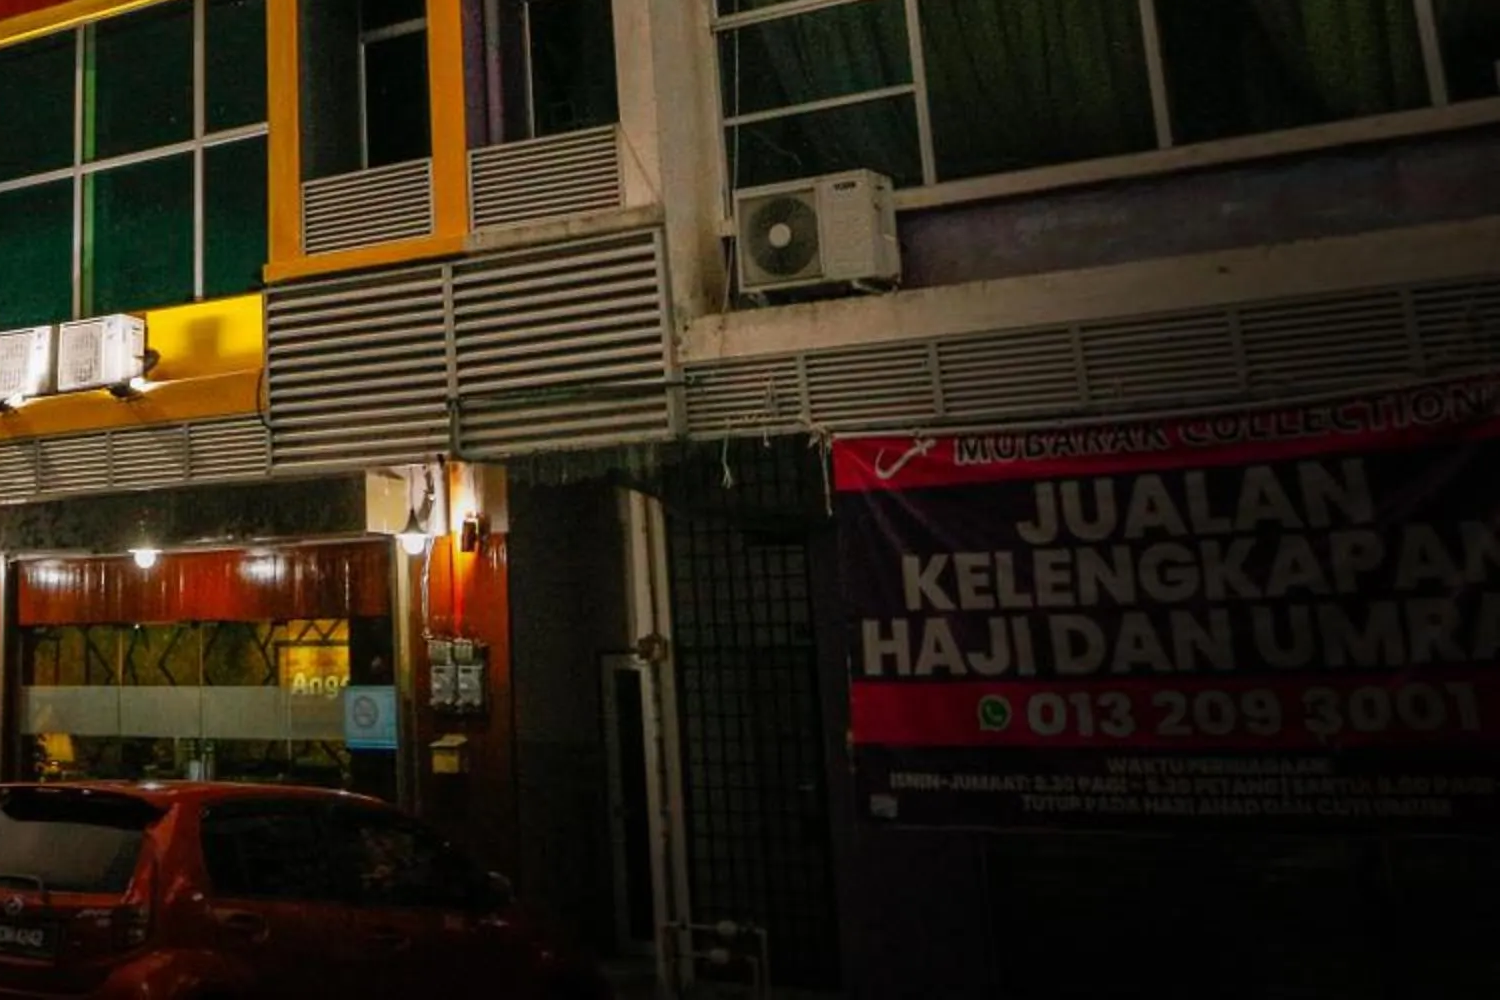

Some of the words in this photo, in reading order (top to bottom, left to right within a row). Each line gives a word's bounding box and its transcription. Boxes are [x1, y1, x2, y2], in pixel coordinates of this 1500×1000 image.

[952, 424, 1172, 466] MUBARAK
[1178, 382, 1492, 444] COLLECTION
[1015, 457, 1376, 546] JUALAN
[861, 615, 1036, 676] HAJI
[1050, 606, 1236, 674] DAN
[290, 671, 350, 699] Ang
[1026, 690, 1136, 738] 013
[1150, 688, 1283, 738] 209
[1302, 681, 1482, 738] 3001
